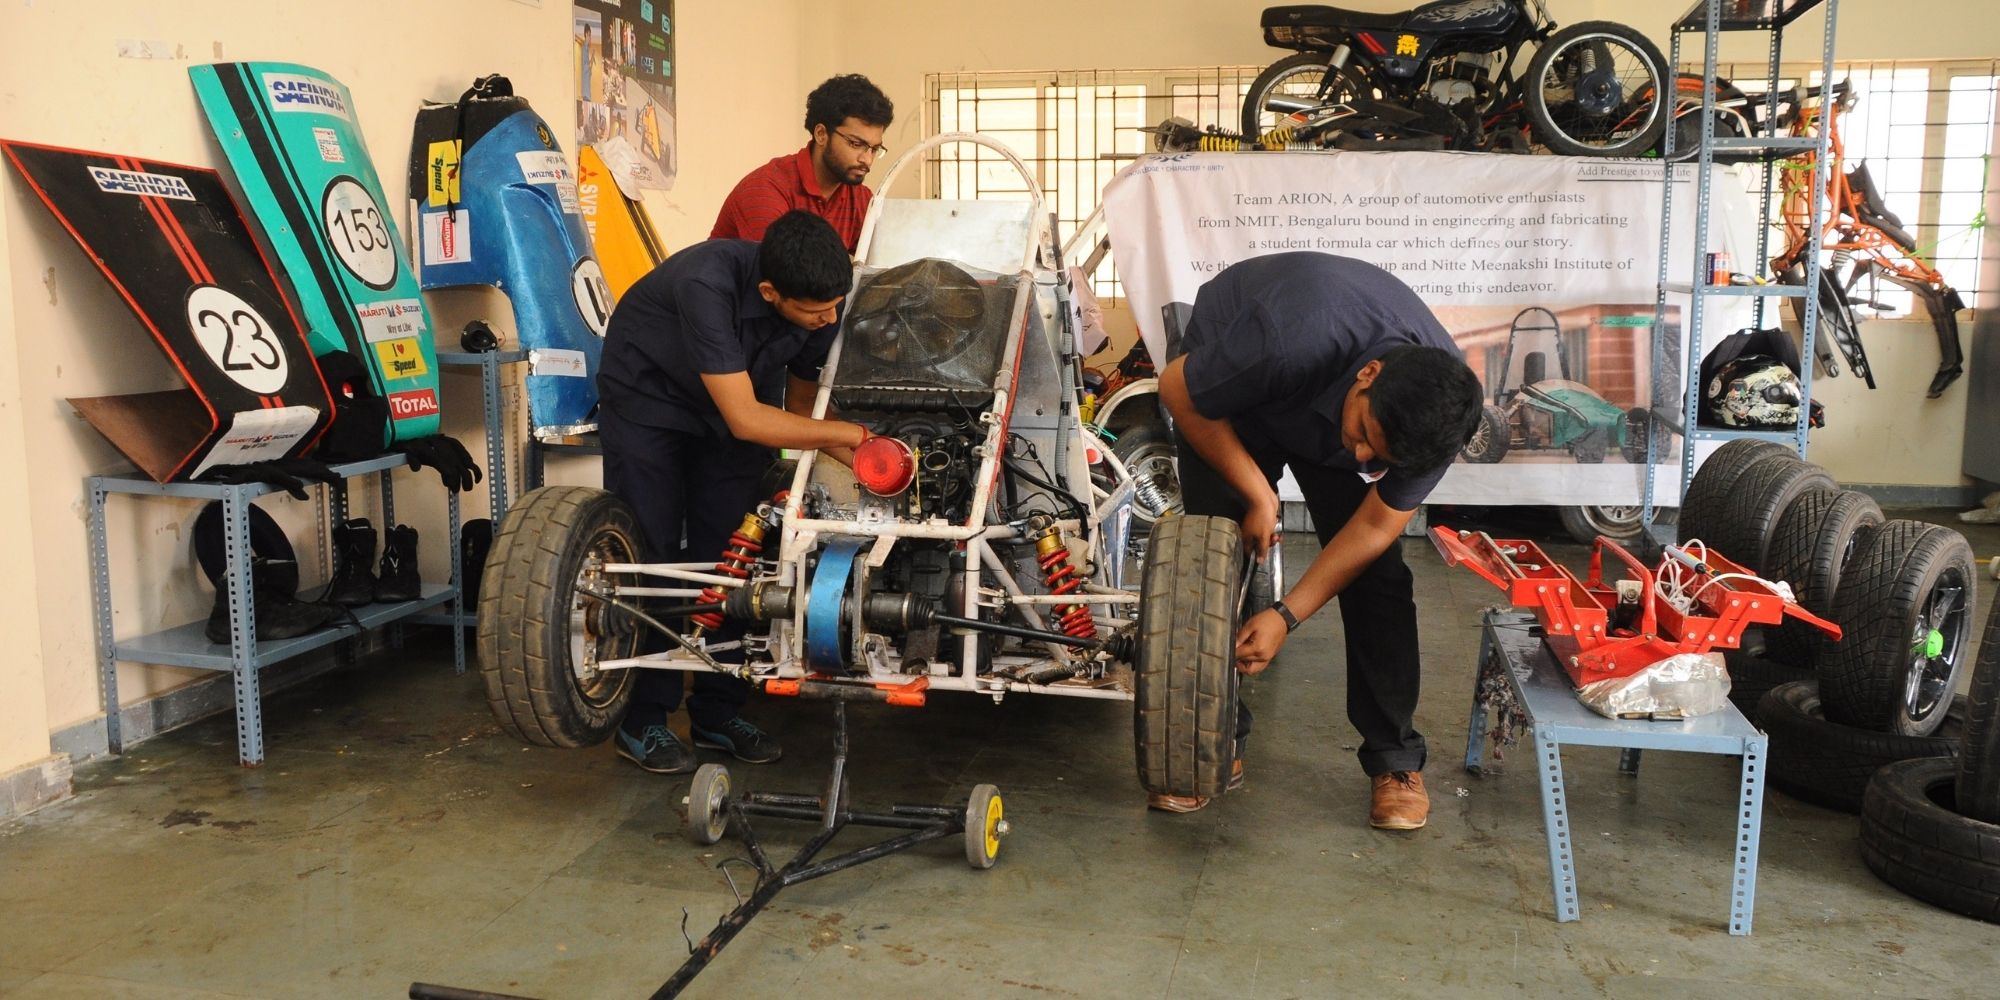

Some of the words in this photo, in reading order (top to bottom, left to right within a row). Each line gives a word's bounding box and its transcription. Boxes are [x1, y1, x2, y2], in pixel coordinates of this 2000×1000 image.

[273, 80, 346, 113] SAEINDIA
[431, 157, 444, 192] Speed
[1165, 164, 1201, 172] CHARACTER
[1207, 164, 1225, 172] UNITY
[1577, 166, 1598, 176] Add
[1600, 166, 1637, 177] Prestige
[1640, 167, 1650, 176] to
[1676, 166, 1692, 177] life
[94, 170, 193, 198] SAEINDIA
[581, 183, 599, 216] SVR
[1234, 193, 1273, 205] Team
[1278, 193, 1338, 206] ARION,
[1342, 193, 1354, 205] A
[1358, 196, 1401, 208] group
[1404, 193, 1421, 204] of
[1424, 193, 1504, 204] automotive
[1508, 191, 1586, 204] enthusiasts
[1198, 216, 1231, 229] from
[1235, 216, 1284, 228] NMIT,
[1288, 215, 1361, 229] Bengaluru
[1366, 215, 1411, 227] bound
[1415, 216, 1428, 227] in
[1432, 215, 1516, 229] engineering
[1520, 215, 1546, 226] and
[1551, 213, 1629, 228] fabricating
[334, 208, 388, 253] 153
[1248, 239, 1256, 249] a
[1260, 237, 1311, 249] student
[1316, 237, 1372, 249] formula
[1376, 239, 1400, 249] car
[1403, 237, 1446, 249] which
[1450, 237, 1501, 249] defines
[1505, 239, 1530, 249] our
[1533, 237, 1574, 250] story.
[1191, 261, 1214, 272] We
[1402, 259, 1427, 271] and
[1431, 259, 1467, 271] Nitte
[1472, 258, 1549, 271] Meenakshi
[1554, 258, 1613, 270] Institute
[1617, 258, 1635, 270] of
[1411, 282, 1454, 294] orting
[1457, 281, 1483, 293] this
[1487, 281, 1557, 293] endeavor.
[360, 308, 387, 317] MARUTI
[198, 309, 280, 371] 23
[392, 343, 398, 357] I
[394, 358, 416, 375] Speed
[391, 396, 438, 413] TOTAL
